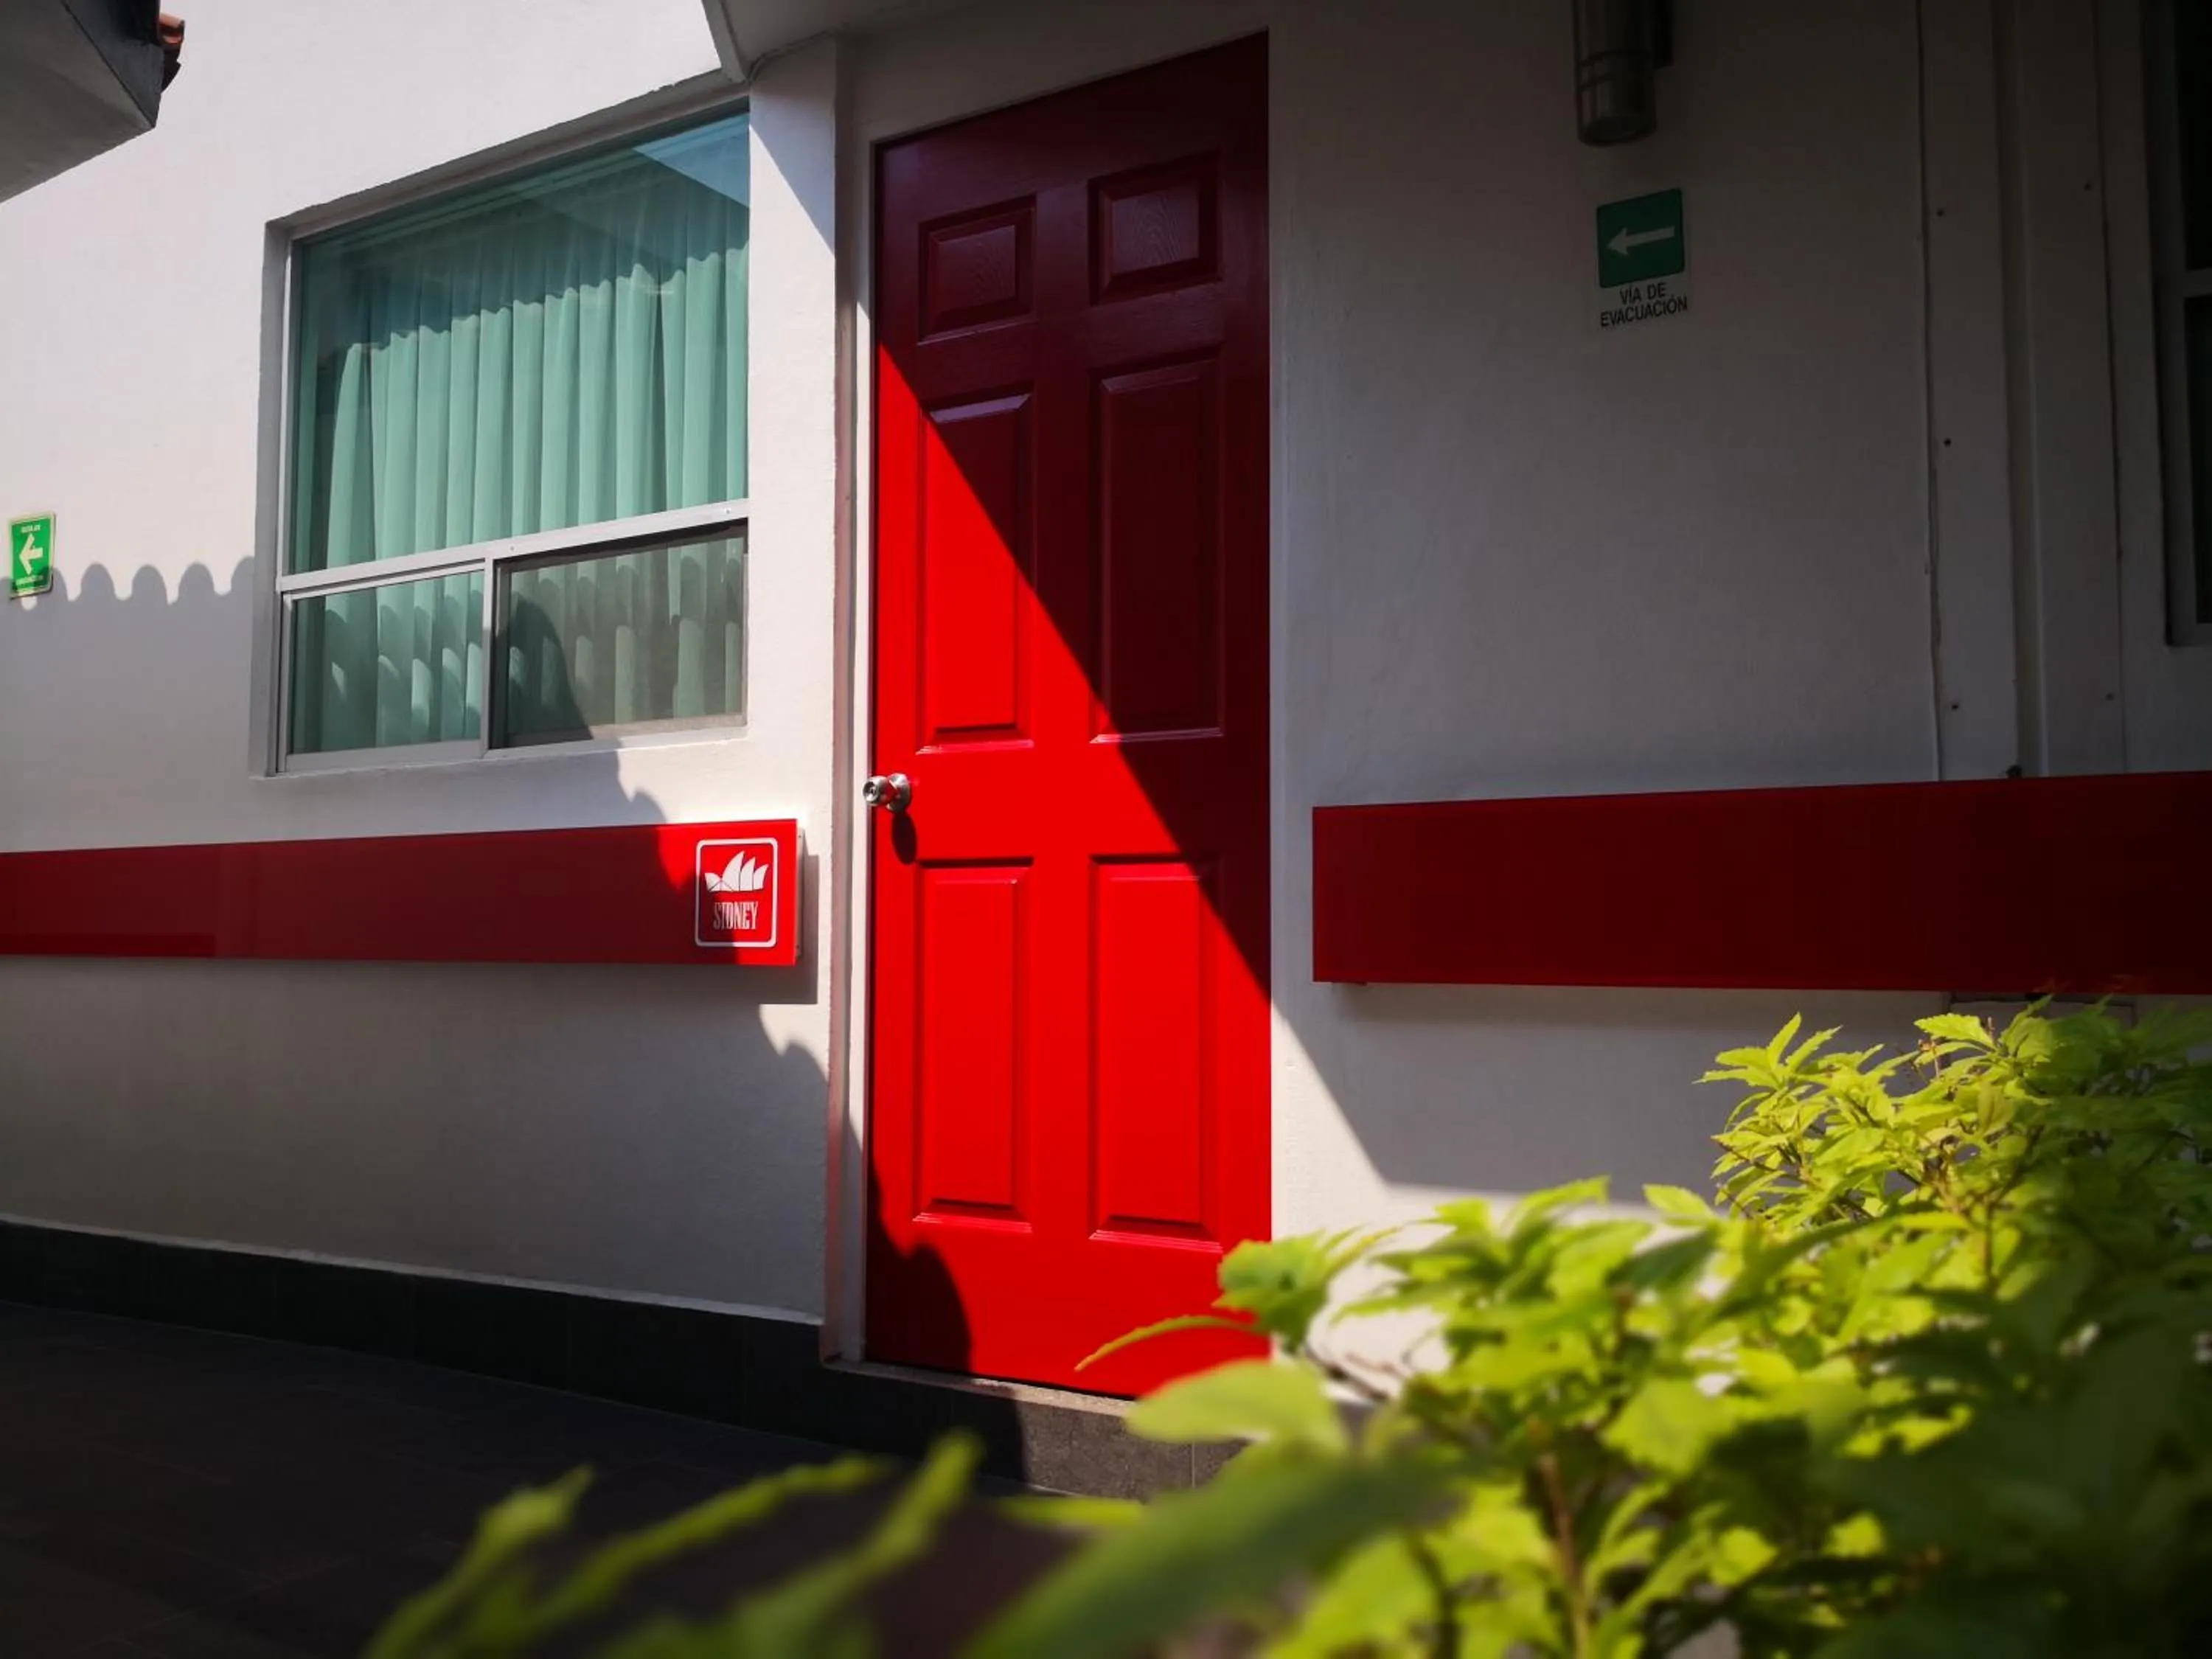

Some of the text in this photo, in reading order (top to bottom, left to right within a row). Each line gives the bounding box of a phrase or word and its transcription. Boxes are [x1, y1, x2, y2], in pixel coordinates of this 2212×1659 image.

[1646, 282, 1667, 300] DE
[1600, 293, 1688, 327] EVACUACIÓN
[713, 900, 759, 931] SIDNEY
